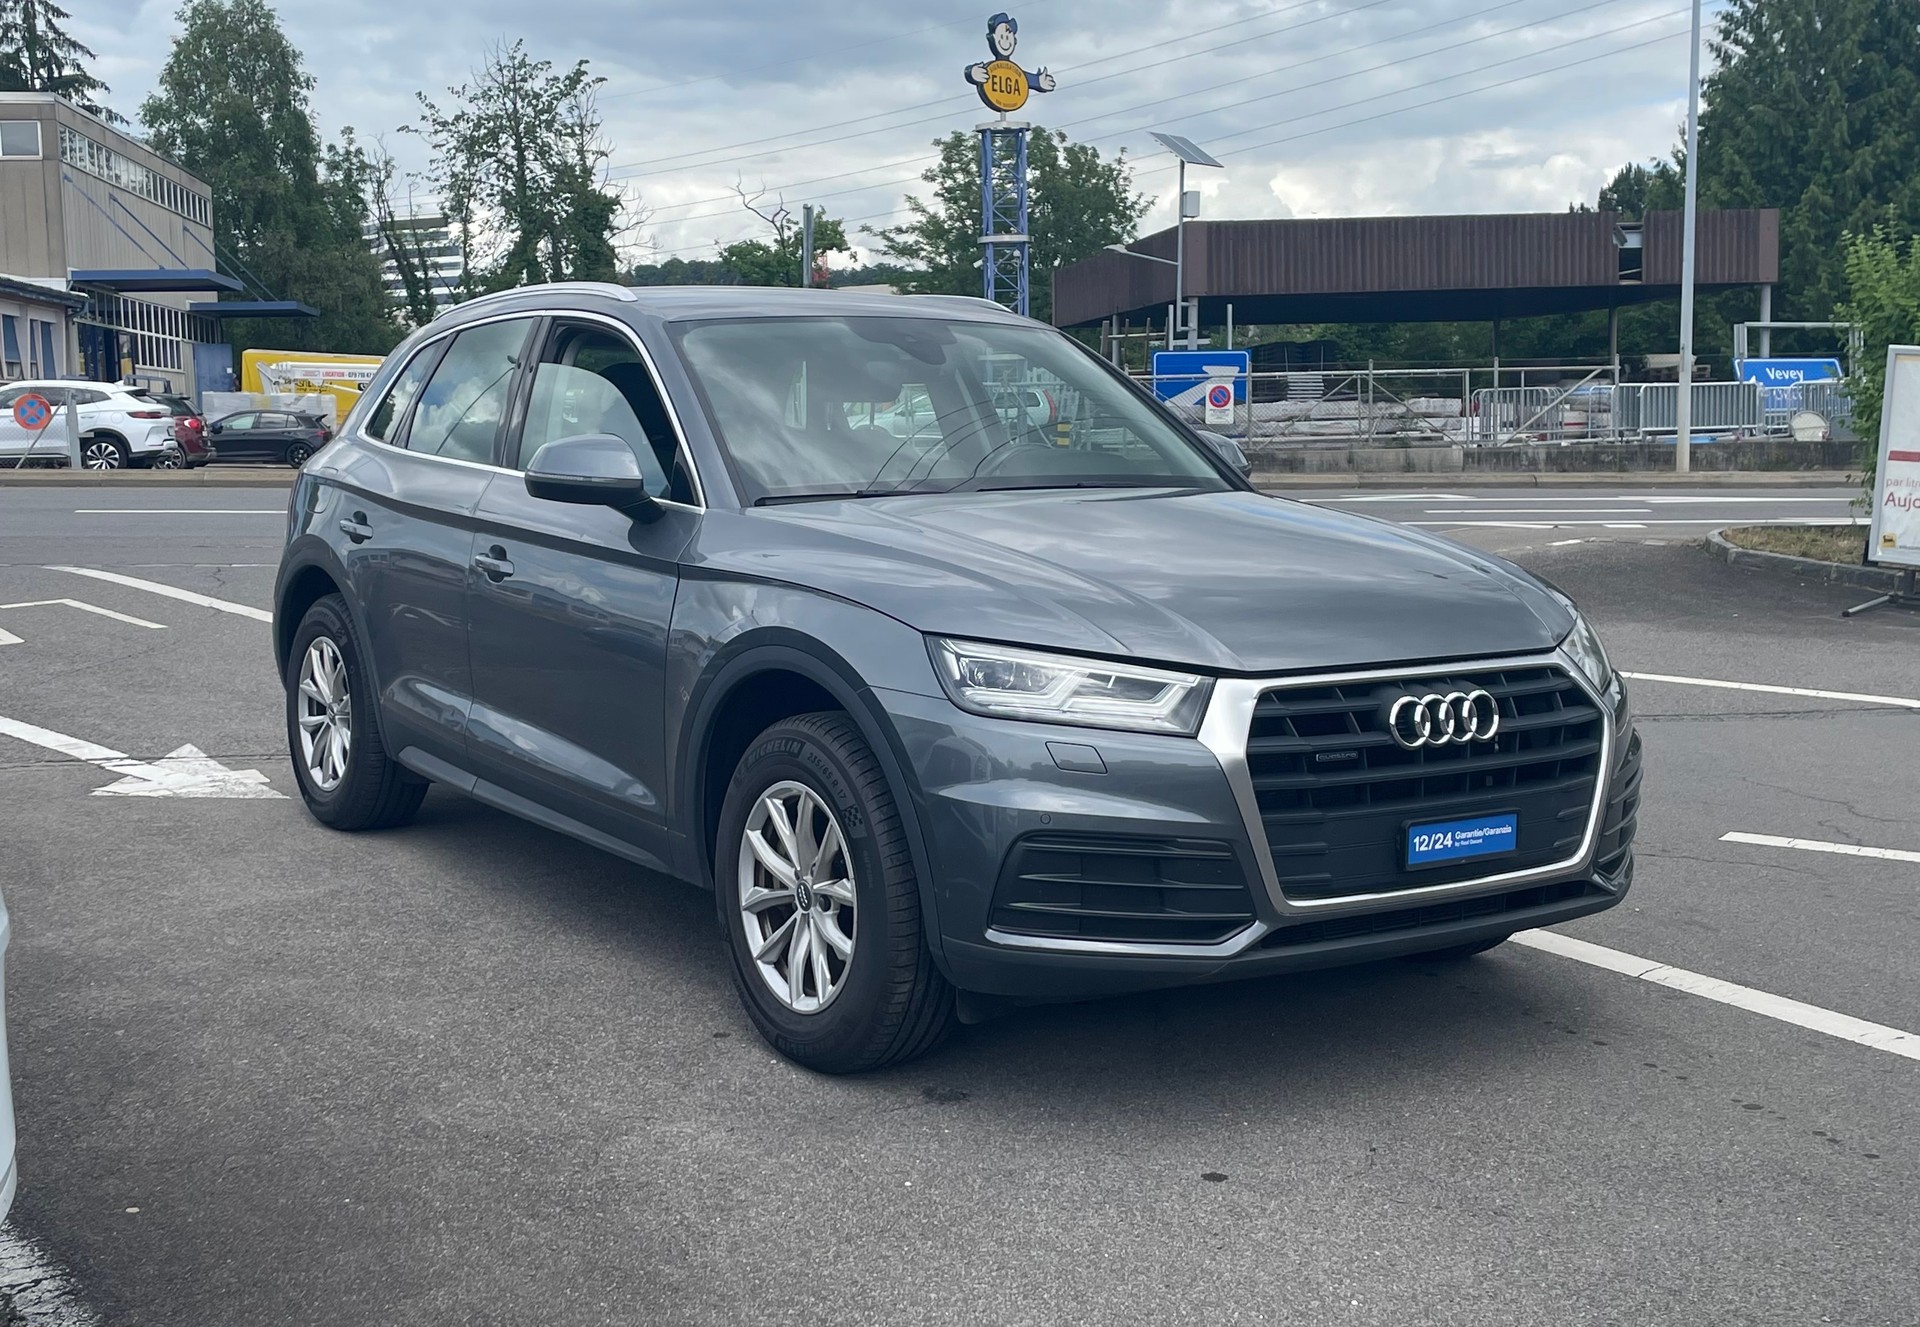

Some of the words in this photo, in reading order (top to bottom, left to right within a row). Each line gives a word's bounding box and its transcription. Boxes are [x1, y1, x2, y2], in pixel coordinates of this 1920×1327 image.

[991, 75, 1021, 96] ELGA
[1766, 367, 1804, 383] Vevey
[1885, 478, 1903, 488] par
[1906, 477, 1920, 488] litr
[747, 740, 803, 766] MICHELIN
[1413, 831, 1453, 852] 12/24
